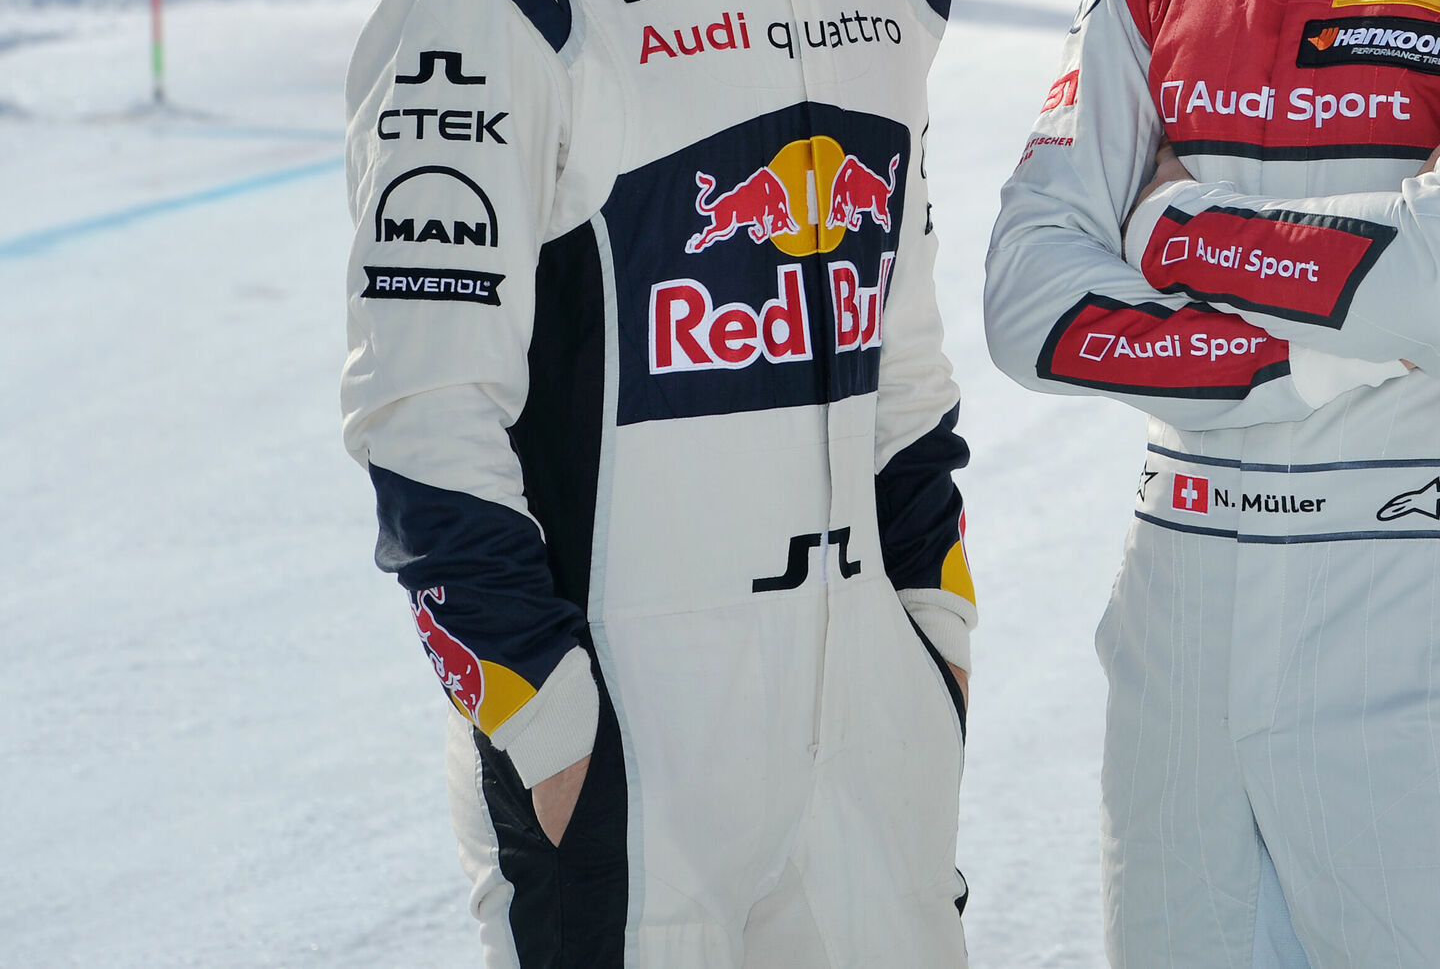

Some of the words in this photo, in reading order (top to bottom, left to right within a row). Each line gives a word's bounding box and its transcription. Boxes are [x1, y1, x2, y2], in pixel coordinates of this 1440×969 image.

[639, 12, 750, 65] Audi
[767, 10, 902, 59] quattro
[1351, 47, 1421, 62] PERFORMANCE
[1185, 80, 1276, 121] Audi
[1287, 87, 1411, 129] Sport
[377, 108, 510, 145] CTEK
[384, 218, 488, 247] MAN
[1196, 237, 1243, 269] Audi
[1244, 248, 1319, 282] Sport
[376, 275, 489, 296] RAVENOL
[650, 264, 813, 374] Red
[1113, 335, 1181, 359] Audi
[1190, 333, 1267, 362] Spor
[1213, 487, 1236, 508] N.
[1241, 493, 1326, 514] Müller
